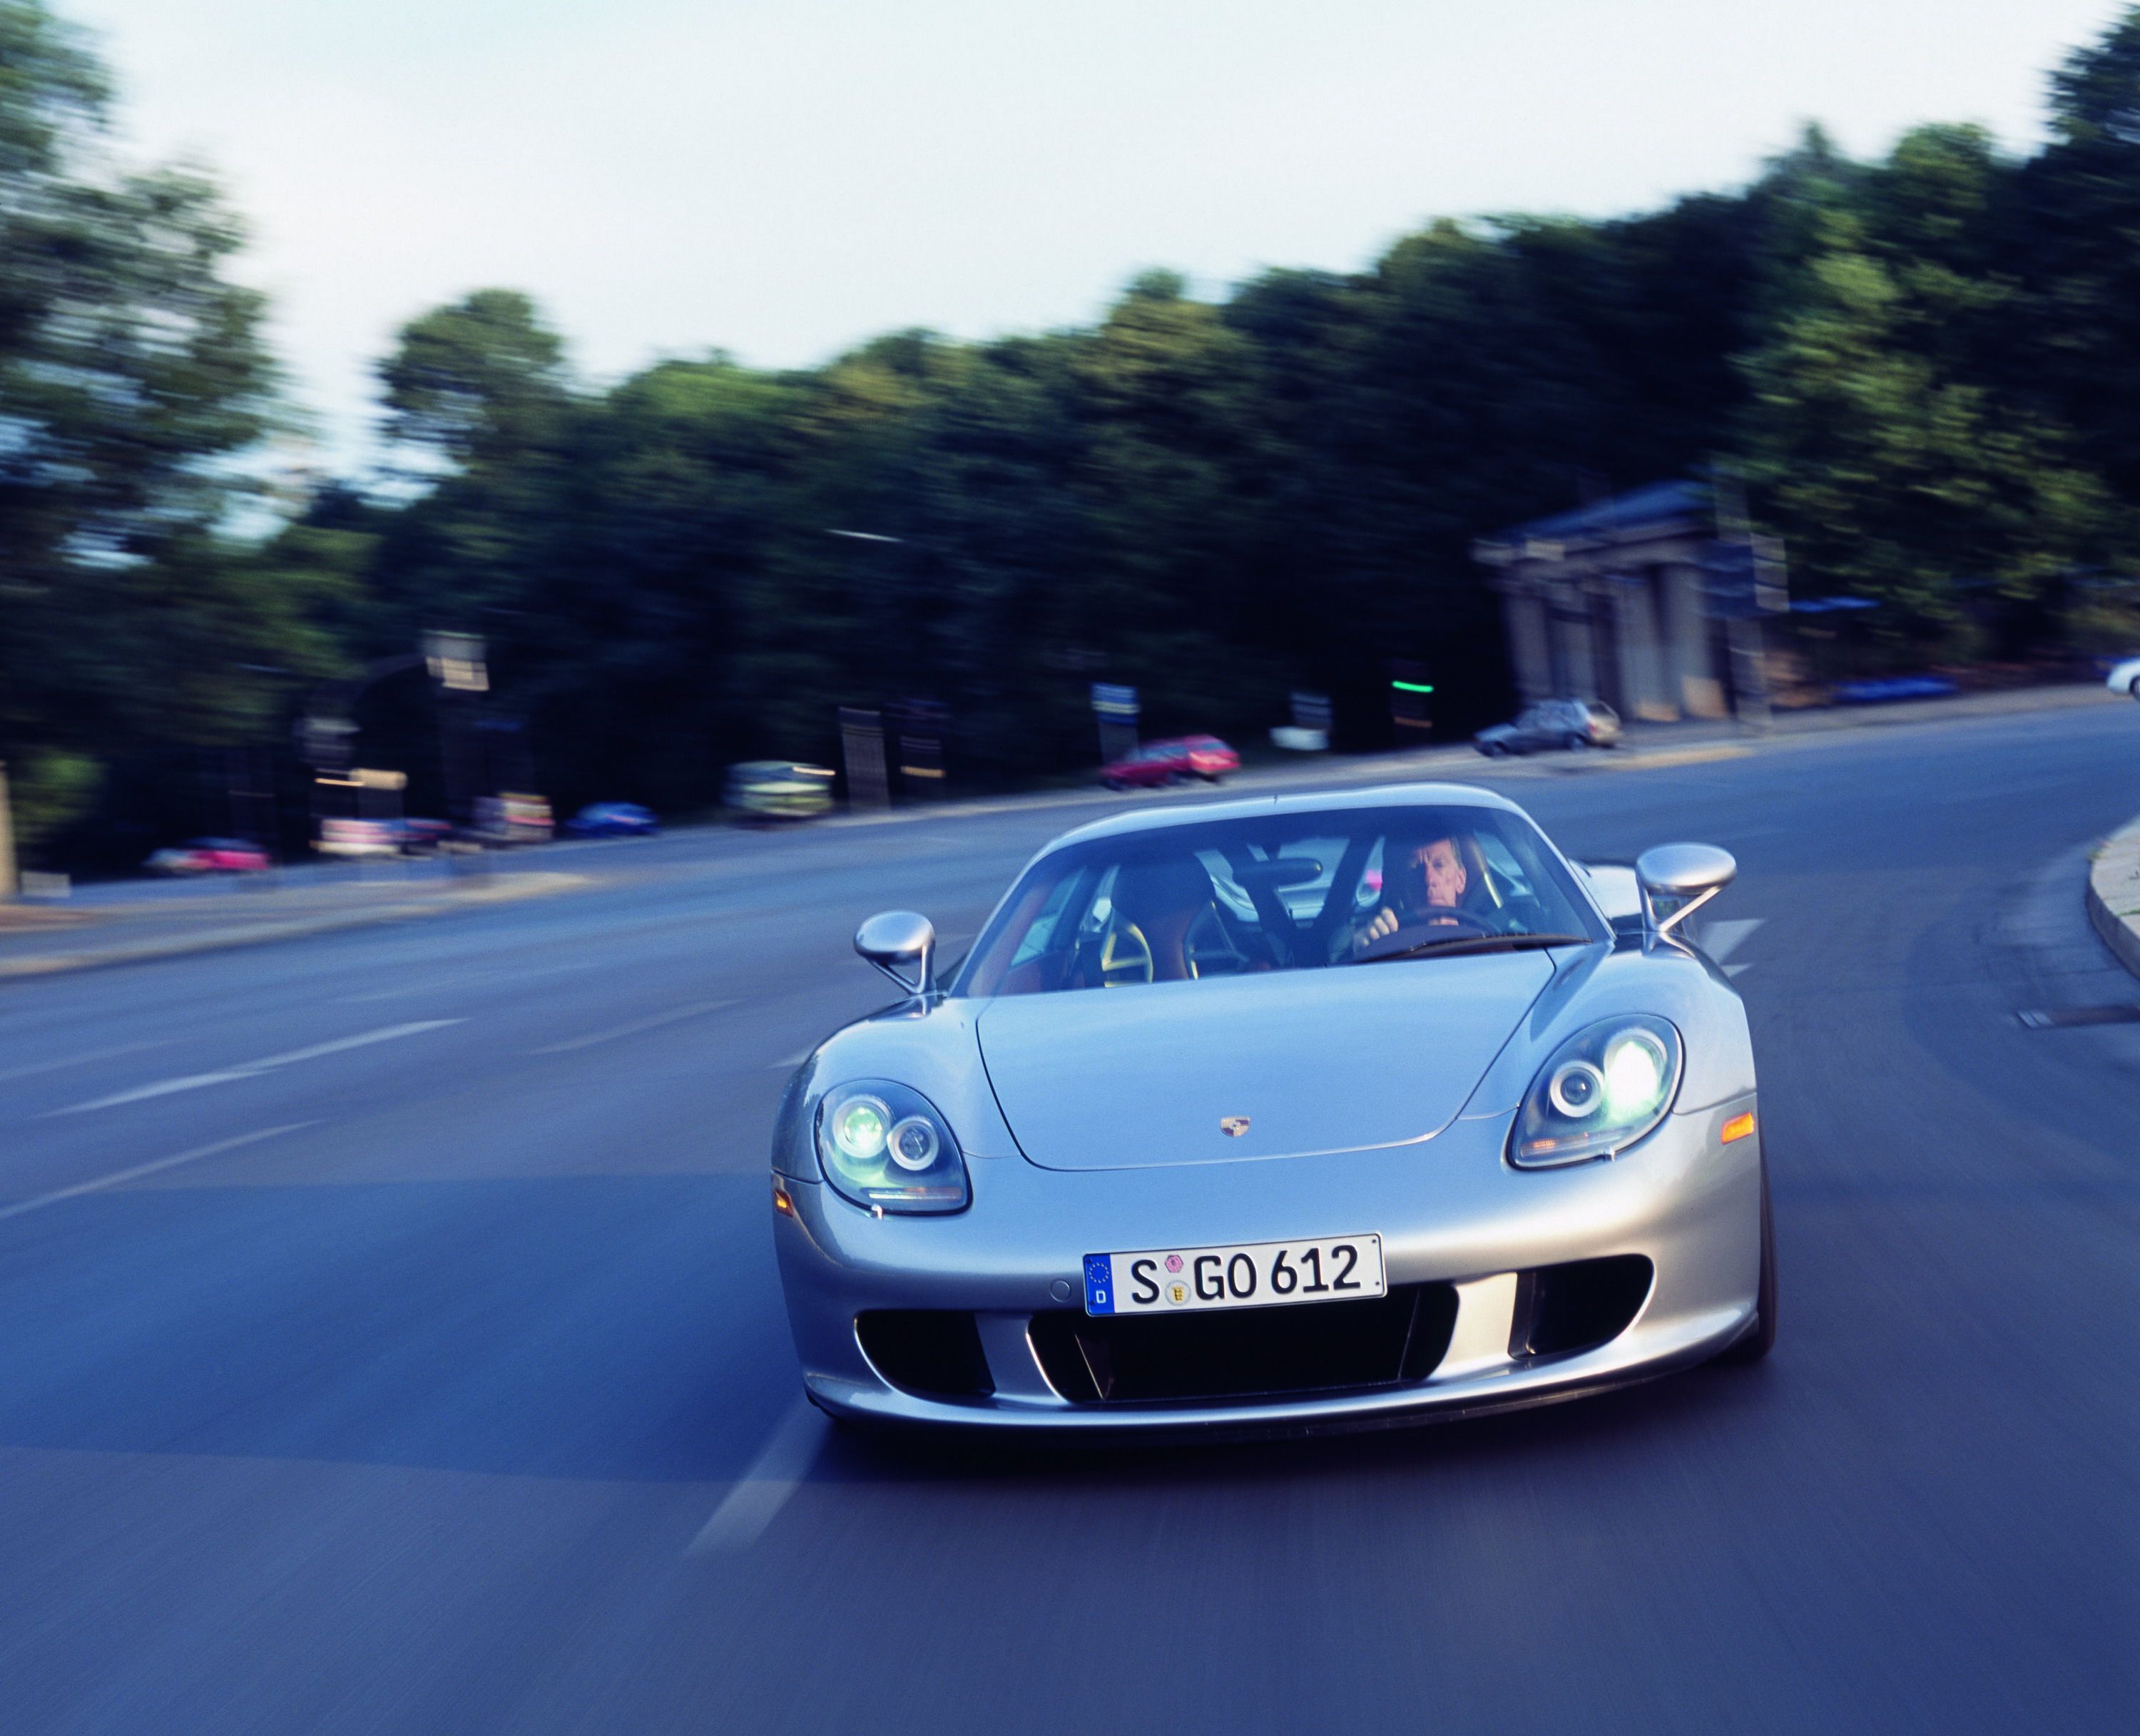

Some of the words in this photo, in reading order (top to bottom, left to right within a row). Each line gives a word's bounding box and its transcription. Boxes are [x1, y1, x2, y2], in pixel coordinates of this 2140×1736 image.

[1131, 1260, 1160, 1304] S
[1193, 1253, 1257, 1300] GO
[1271, 1245, 1361, 1295] 612
[1096, 1290, 1106, 1304] D
